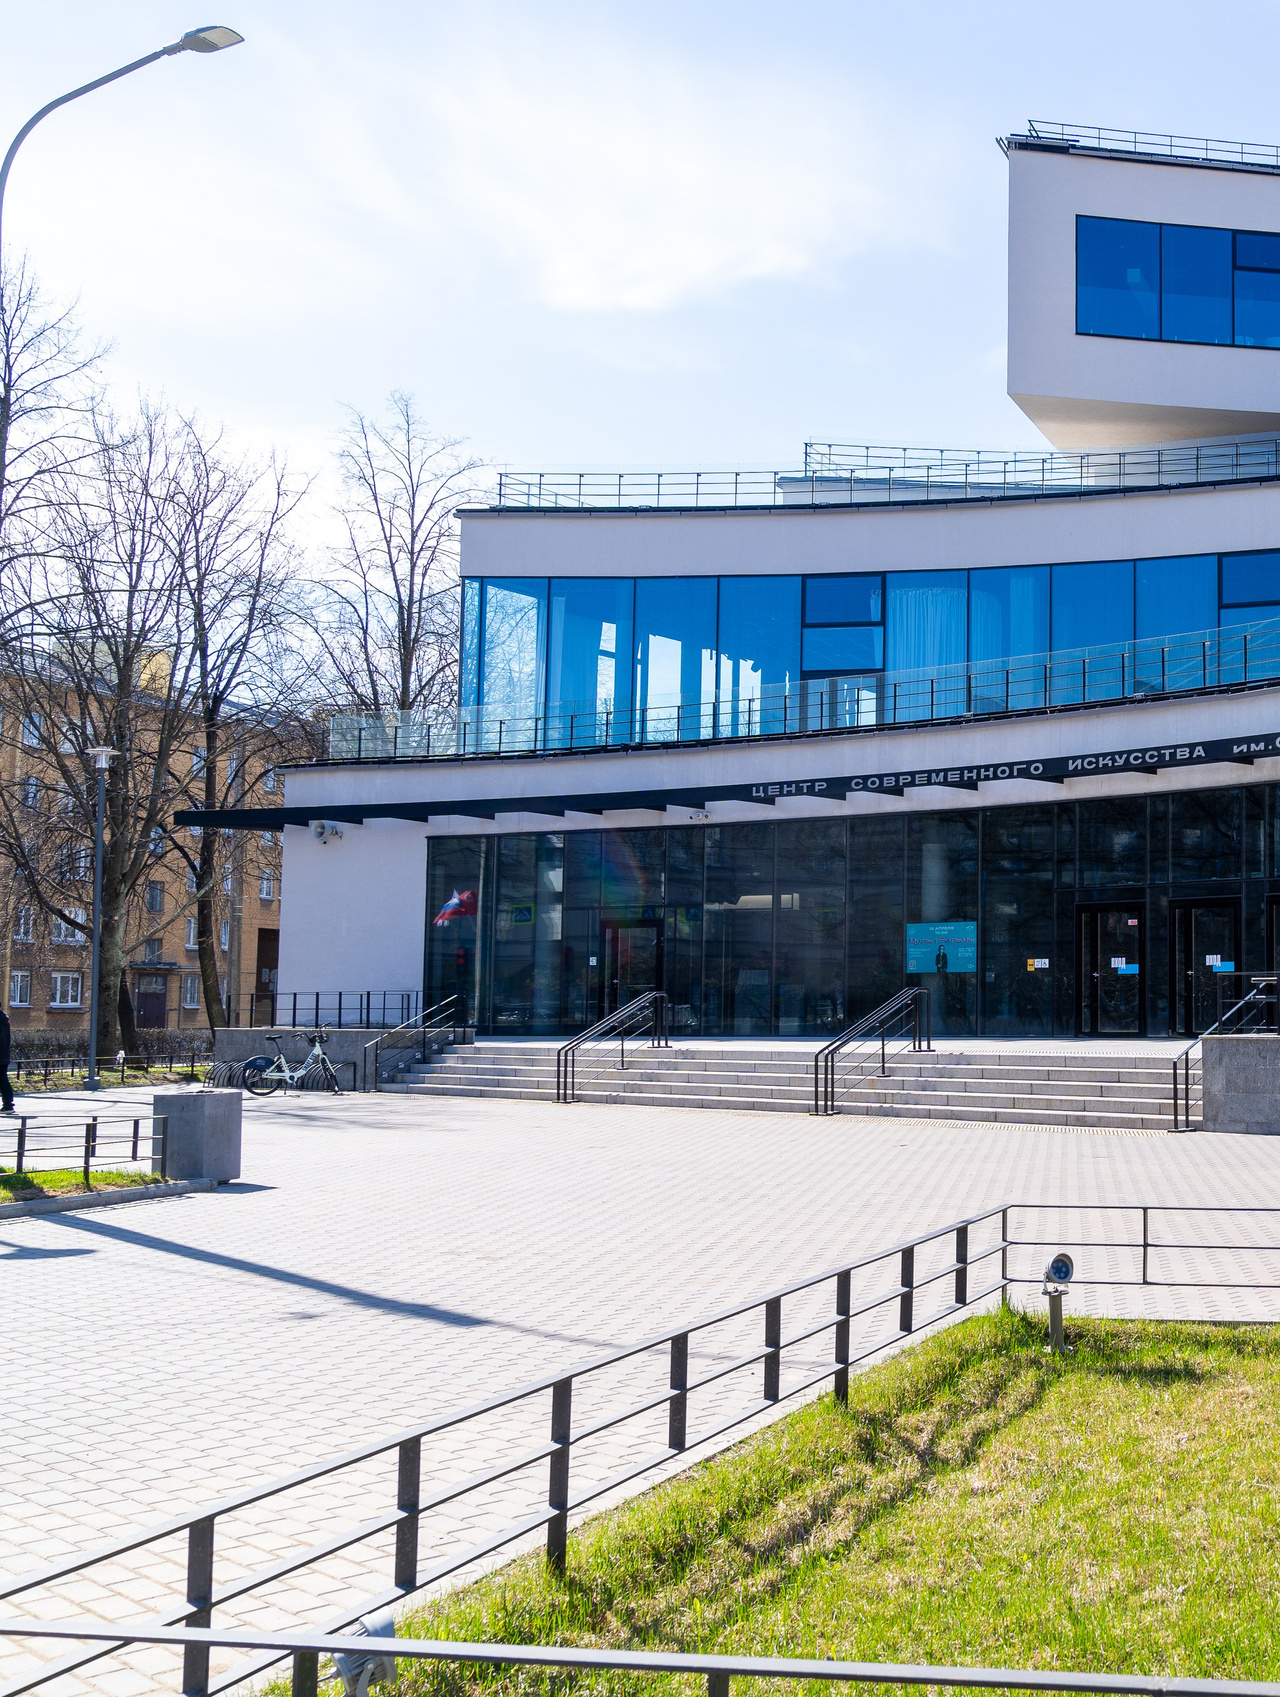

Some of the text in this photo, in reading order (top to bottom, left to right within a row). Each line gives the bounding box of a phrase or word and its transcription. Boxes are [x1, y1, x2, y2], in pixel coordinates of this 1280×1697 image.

[752, 781, 828, 798] ЦЕНТР
[851, 762, 1044, 790] СОВРЕМЕННОГО
[1068, 745, 1206, 771] ИСКУССТВА
